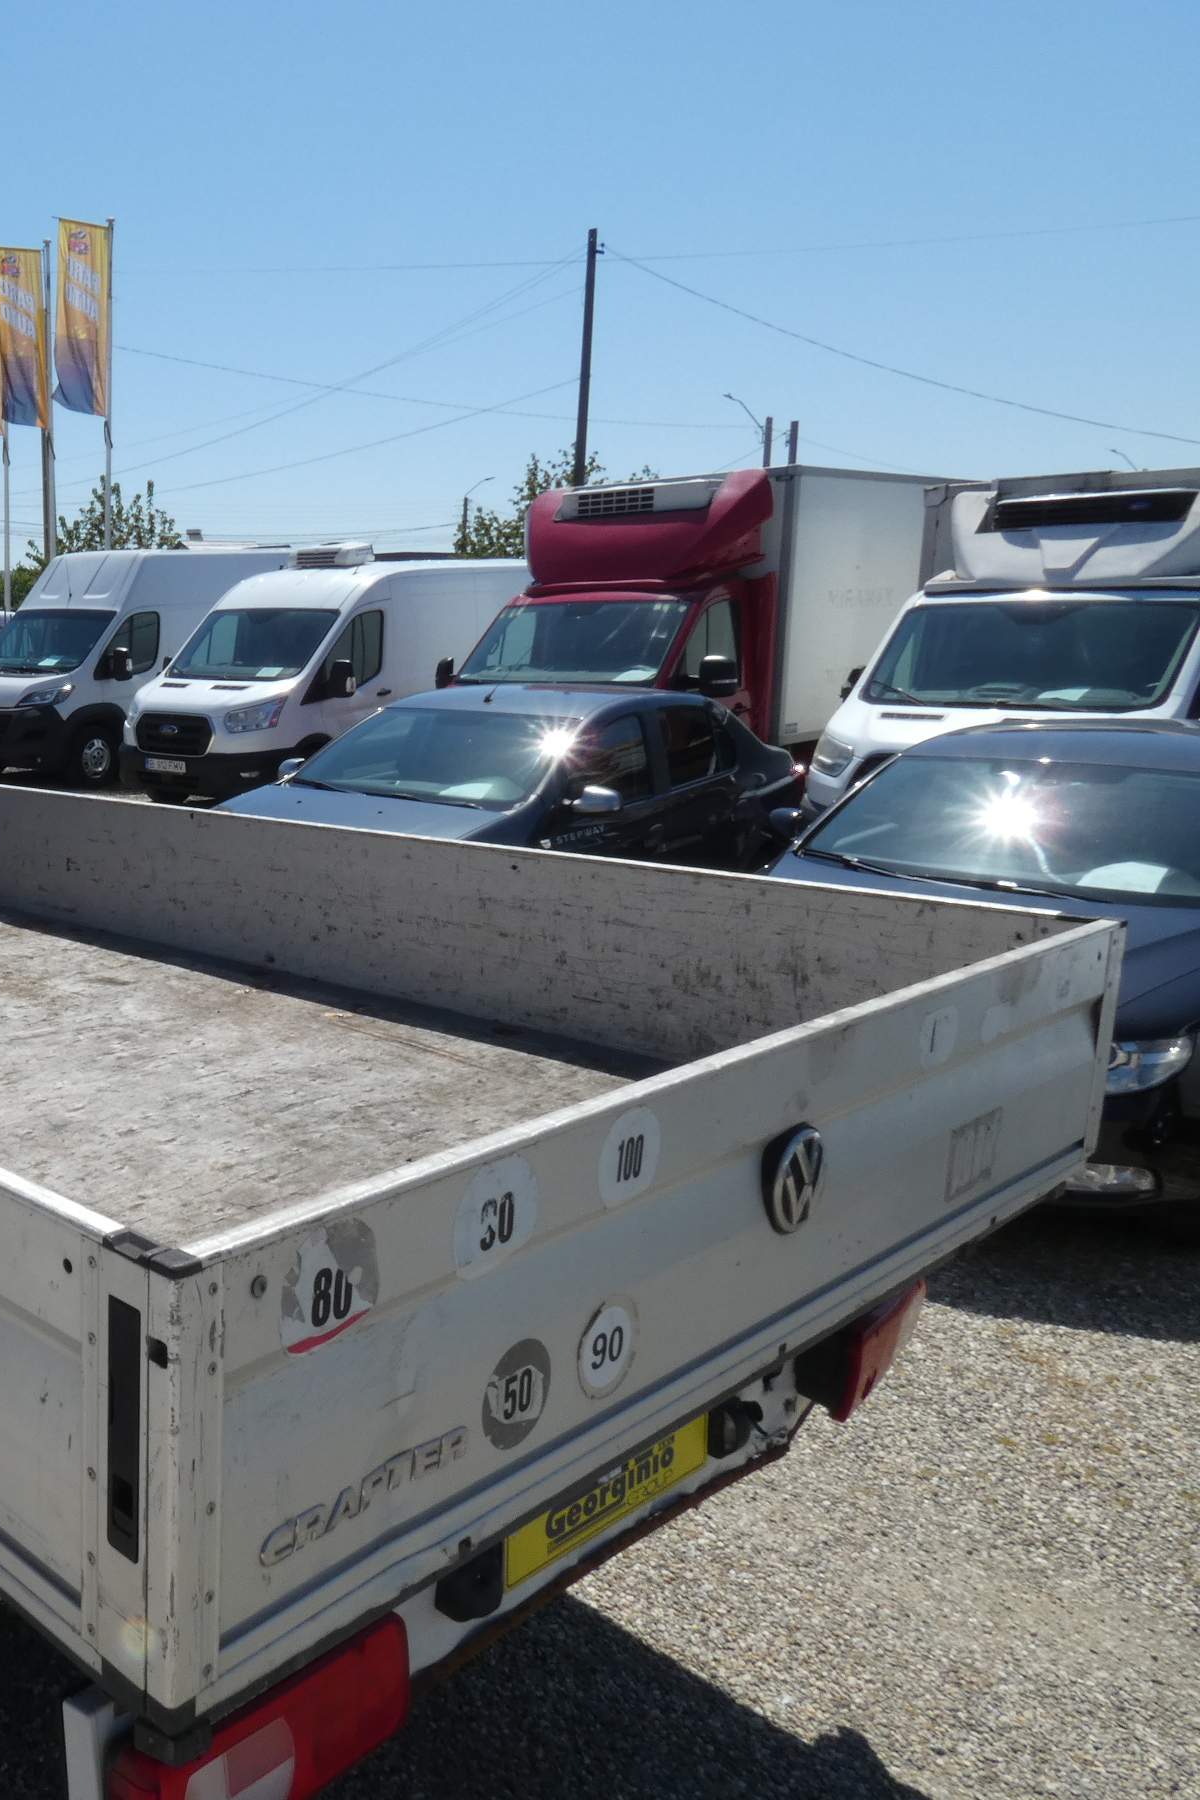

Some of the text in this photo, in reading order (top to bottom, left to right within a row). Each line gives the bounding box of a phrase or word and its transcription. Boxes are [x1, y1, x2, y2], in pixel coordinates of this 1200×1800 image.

[556, 824, 605, 844] STEPWAY
[616, 1134, 644, 1182] 100
[311, 1267, 352, 1327] 80
[591, 1325, 624, 1370] 90
[503, 1368, 532, 1420] 50
[259, 1425, 468, 1567] CRAFTER
[546, 1446, 675, 1539] Georginio
